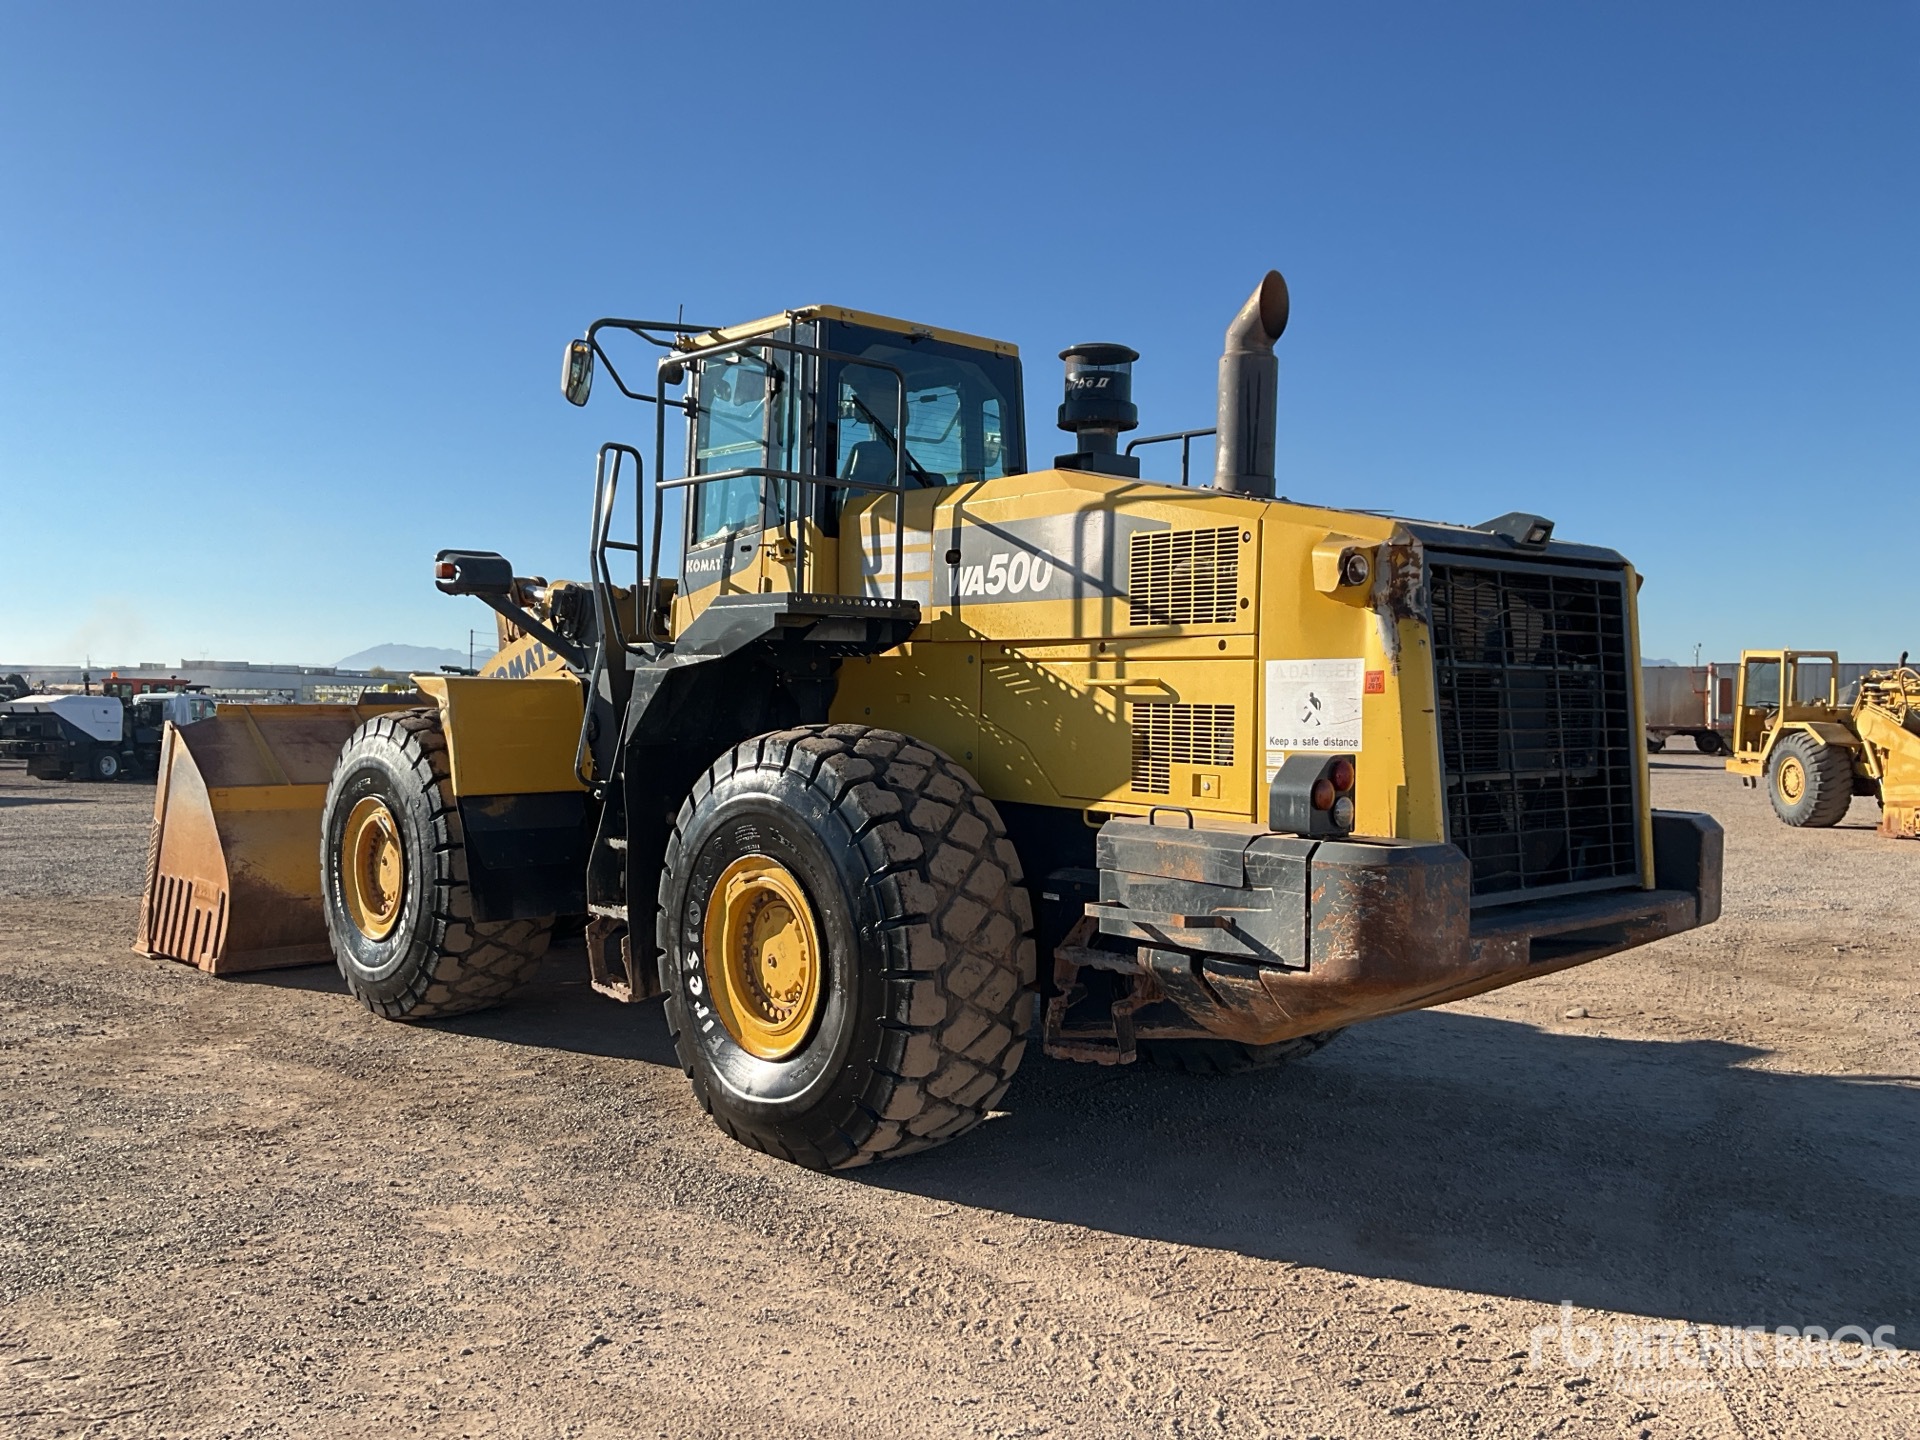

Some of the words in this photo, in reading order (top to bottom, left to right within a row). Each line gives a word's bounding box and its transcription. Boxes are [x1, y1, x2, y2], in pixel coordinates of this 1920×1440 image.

[948, 549, 1054, 597] WA500
[1269, 736, 1289, 749] Keep
[1292, 738, 1298, 746] a
[1302, 736, 1319, 747] safe
[1323, 737, 1359, 747] distance
